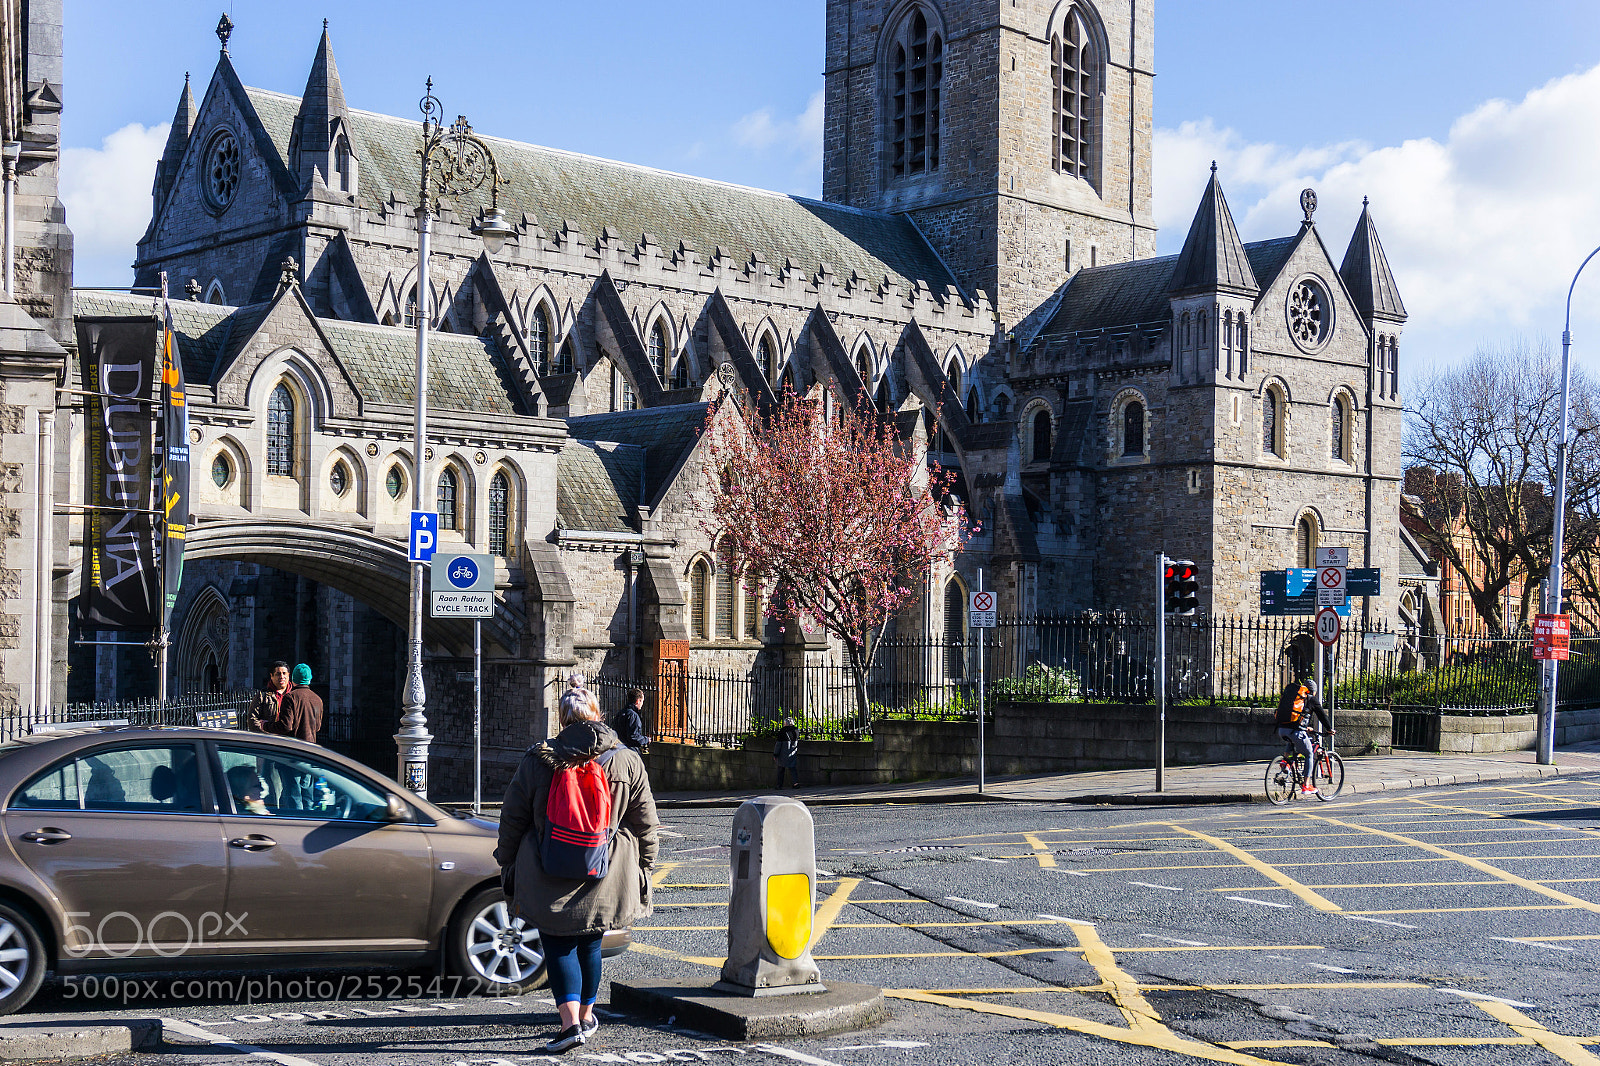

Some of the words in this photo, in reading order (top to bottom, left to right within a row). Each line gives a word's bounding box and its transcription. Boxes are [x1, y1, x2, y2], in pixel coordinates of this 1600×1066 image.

[91, 430, 101, 466] VIKING
[103, 360, 142, 590] DUBLINIA
[415, 530, 434, 559] P
[91, 547, 101, 588] DUBLIN
[438, 594, 458, 602] Raon
[460, 594, 487, 603] Rothar
[435, 604, 461, 612] CYCLE
[463, 605, 490, 613] TRACK
[1321, 616, 1335, 633] 30
[1538, 619, 1559, 628] Protest
[1552, 627, 1569, 635] Crime
[186, 1010, 347, 1026] LOOK
